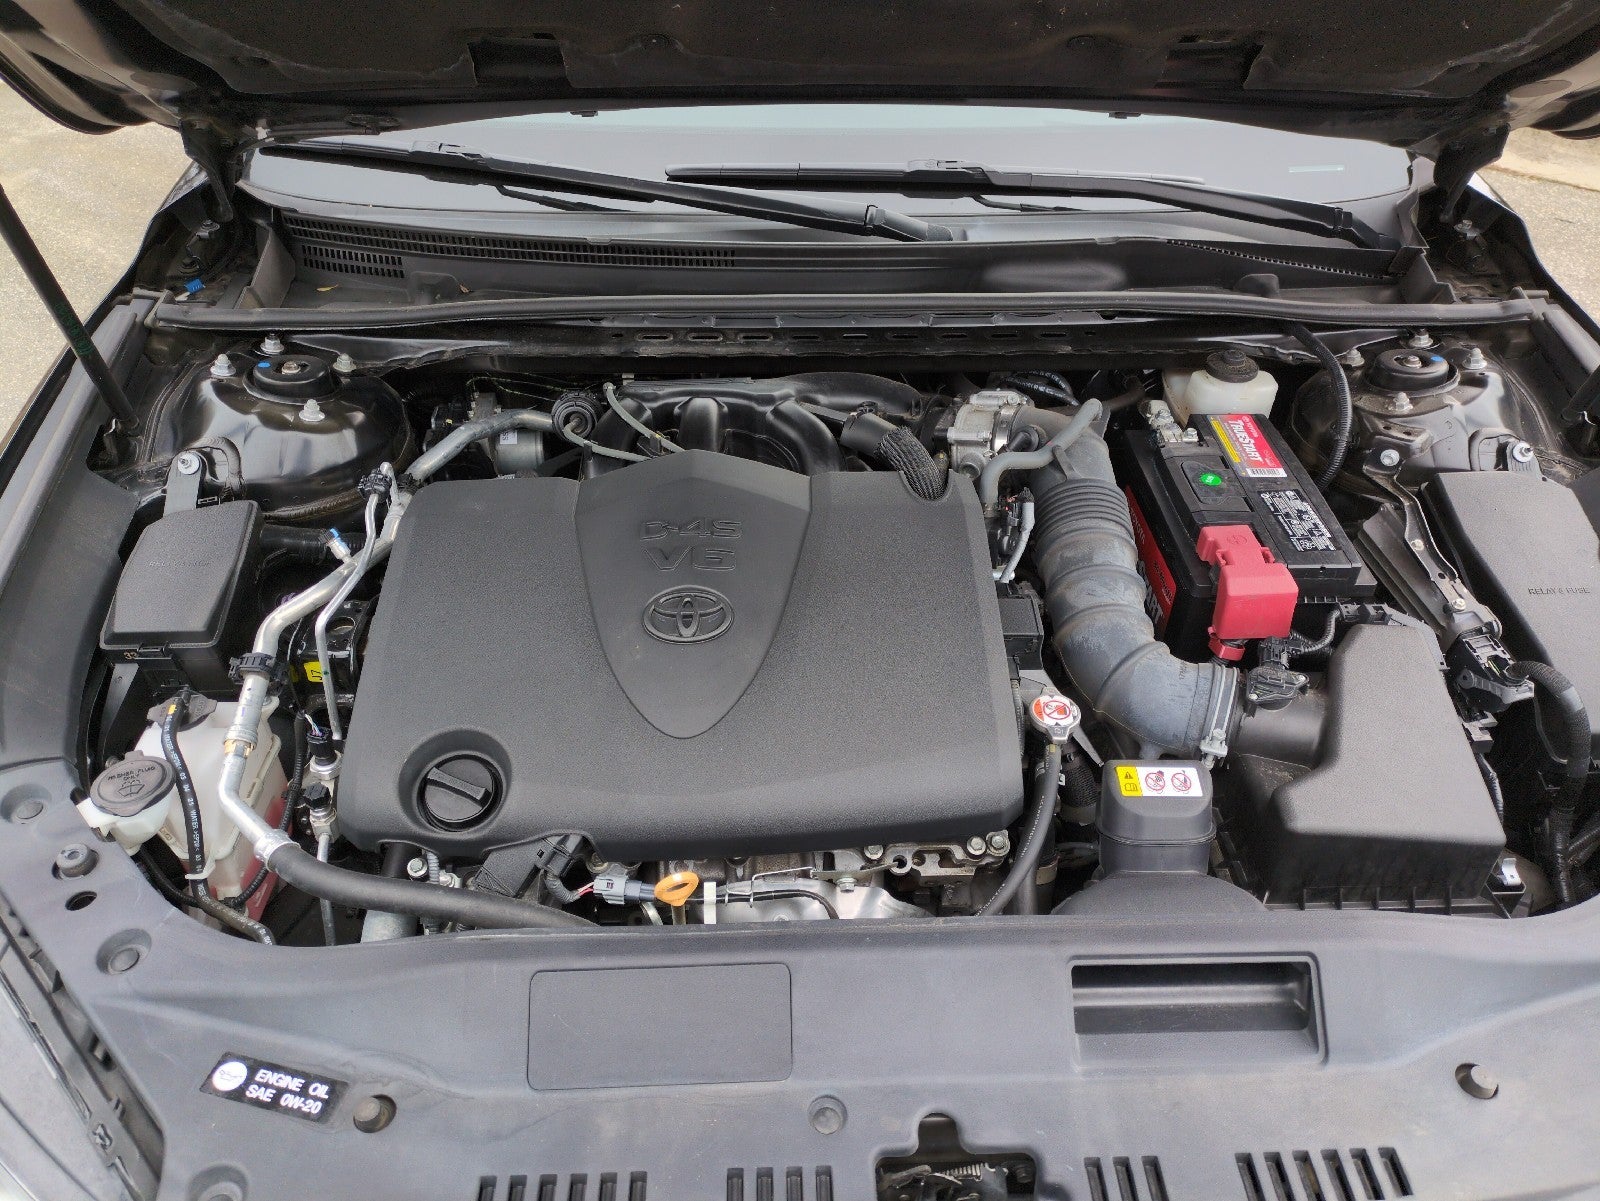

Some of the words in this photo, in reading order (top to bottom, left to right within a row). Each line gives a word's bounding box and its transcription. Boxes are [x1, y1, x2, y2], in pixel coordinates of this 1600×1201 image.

[642, 544, 737, 571] V6
[1528, 587, 1556, 595] RELAY
[190, 810, 199, 830] WATER
[254, 1069, 305, 1092] ENGINE
[308, 1082, 330, 1100] OIL
[245, 1084, 276, 1102] SAE
[279, 1093, 323, 1114] 0W-20
